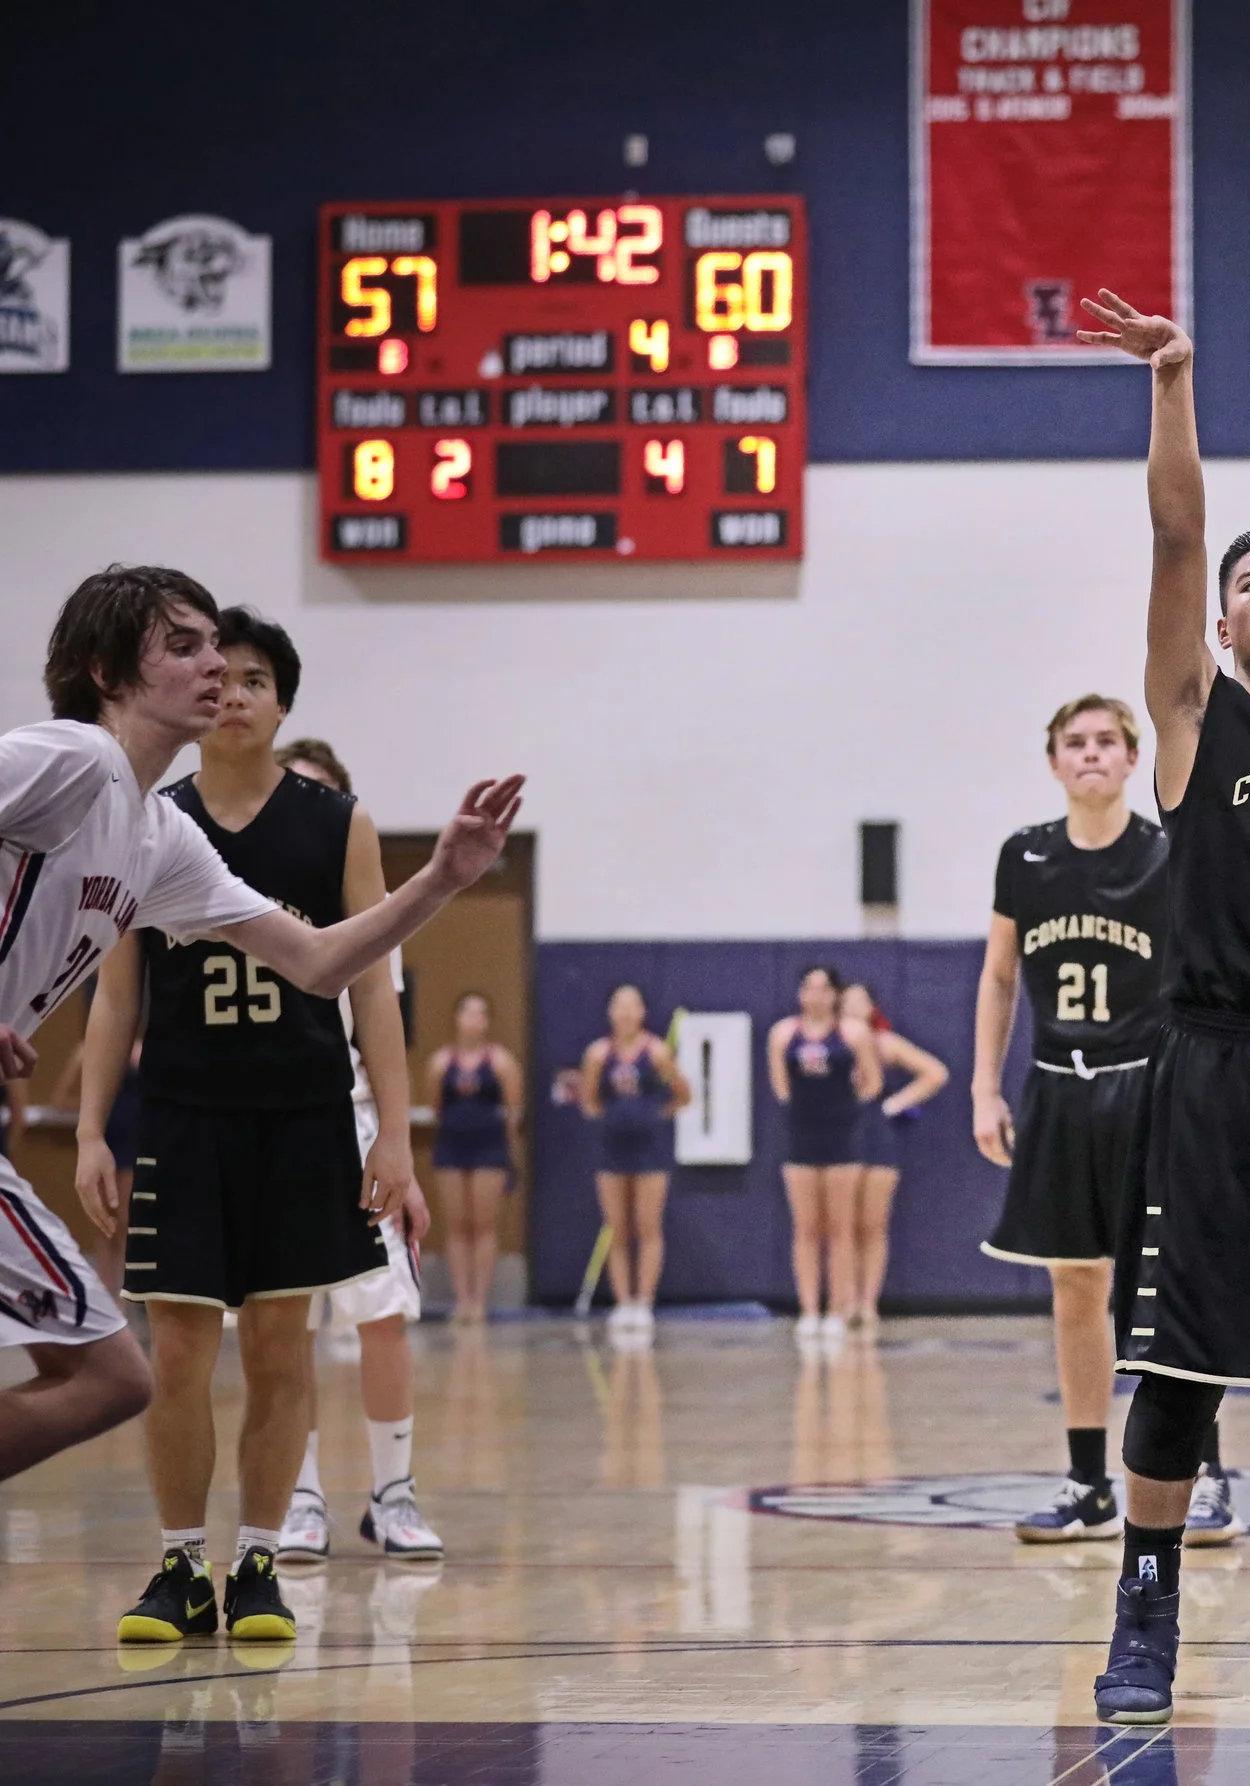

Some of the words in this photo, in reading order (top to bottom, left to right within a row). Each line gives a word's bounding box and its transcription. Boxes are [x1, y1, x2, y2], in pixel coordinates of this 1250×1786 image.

[961, 25, 1139, 61] CHAMPIONS
[1068, 63, 1144, 93] FIELD
[342, 215, 426, 252] Home
[531, 205, 663, 285] 1:42
[685, 208, 790, 249] Guests
[341, 256, 437, 337] 57
[696, 251, 793, 332] 60
[510, 331, 607, 374] period
[629, 319, 669, 373] 4
[510, 384, 608, 429] player
[354, 440, 395, 500] 8
[431, 439, 472, 499] 2
[645, 439, 684, 494] 4
[738, 436, 776, 493] 7
[339, 518, 399, 548] won
[520, 515, 597, 553] game
[719, 513, 780, 545] won
[1024, 914, 1152, 960] COMANCHES
[203, 955, 282, 1025] 25
[1056, 962, 1111, 1022] 21
